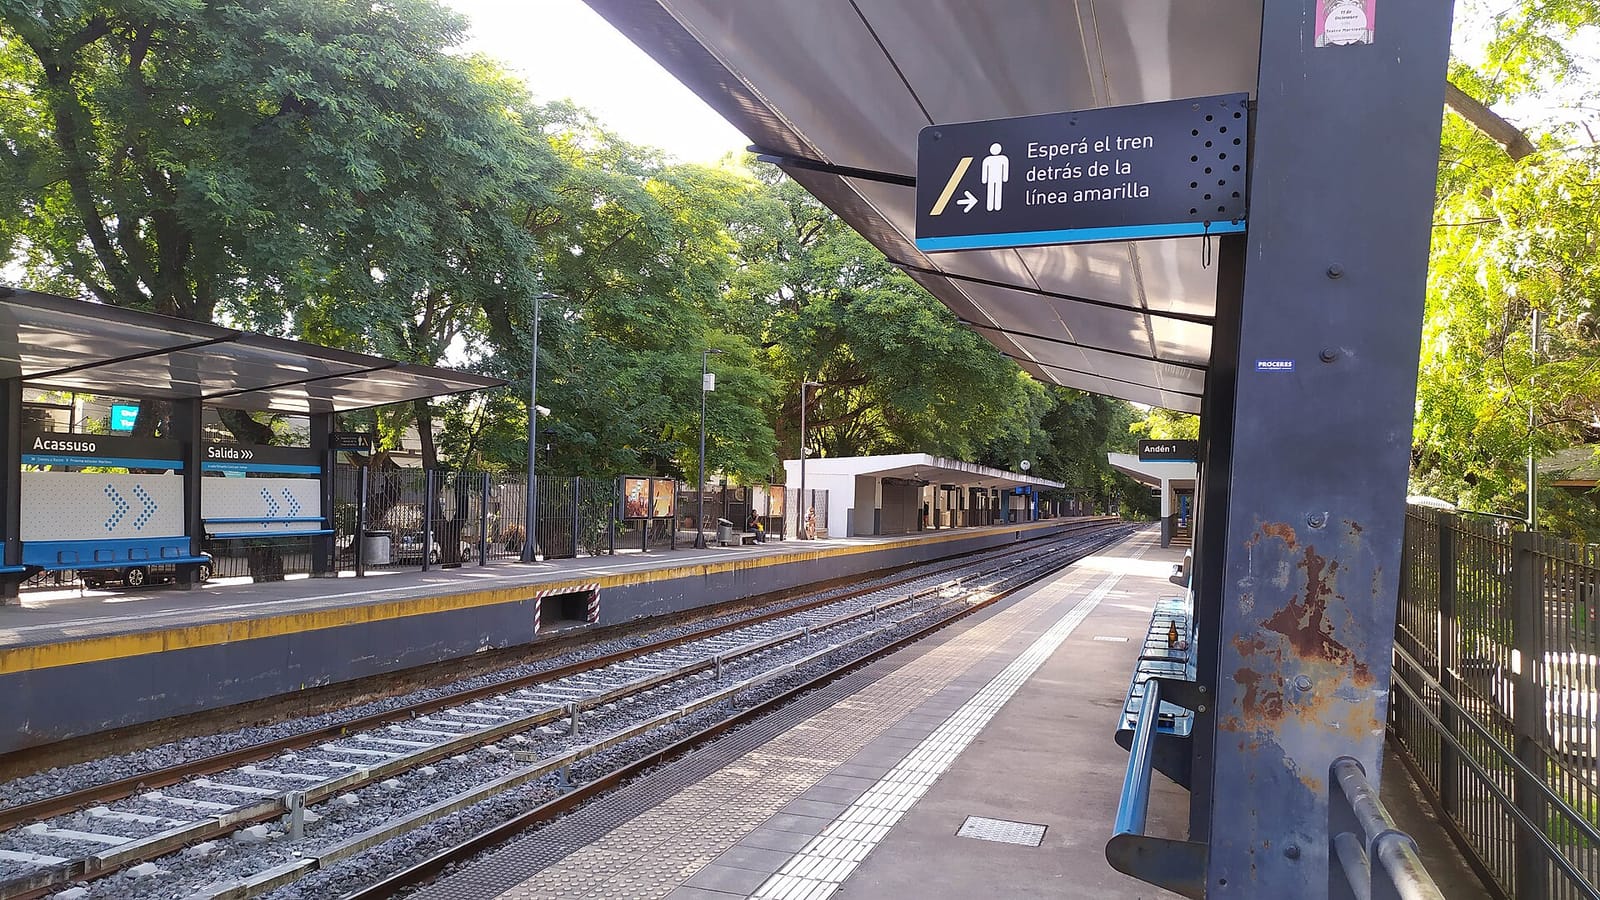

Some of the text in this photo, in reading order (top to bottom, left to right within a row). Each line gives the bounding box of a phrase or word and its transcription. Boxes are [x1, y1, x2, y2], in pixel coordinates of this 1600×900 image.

[1027, 135, 1153, 161] Esperá el tren
[1026, 159, 1131, 182] detrás de la
[1025, 182, 1149, 205] línea amarilla
[33, 436, 96, 452] Acassuso
[207, 446, 239, 459] Salida
[1144, 444, 1176, 453] Andén 1
